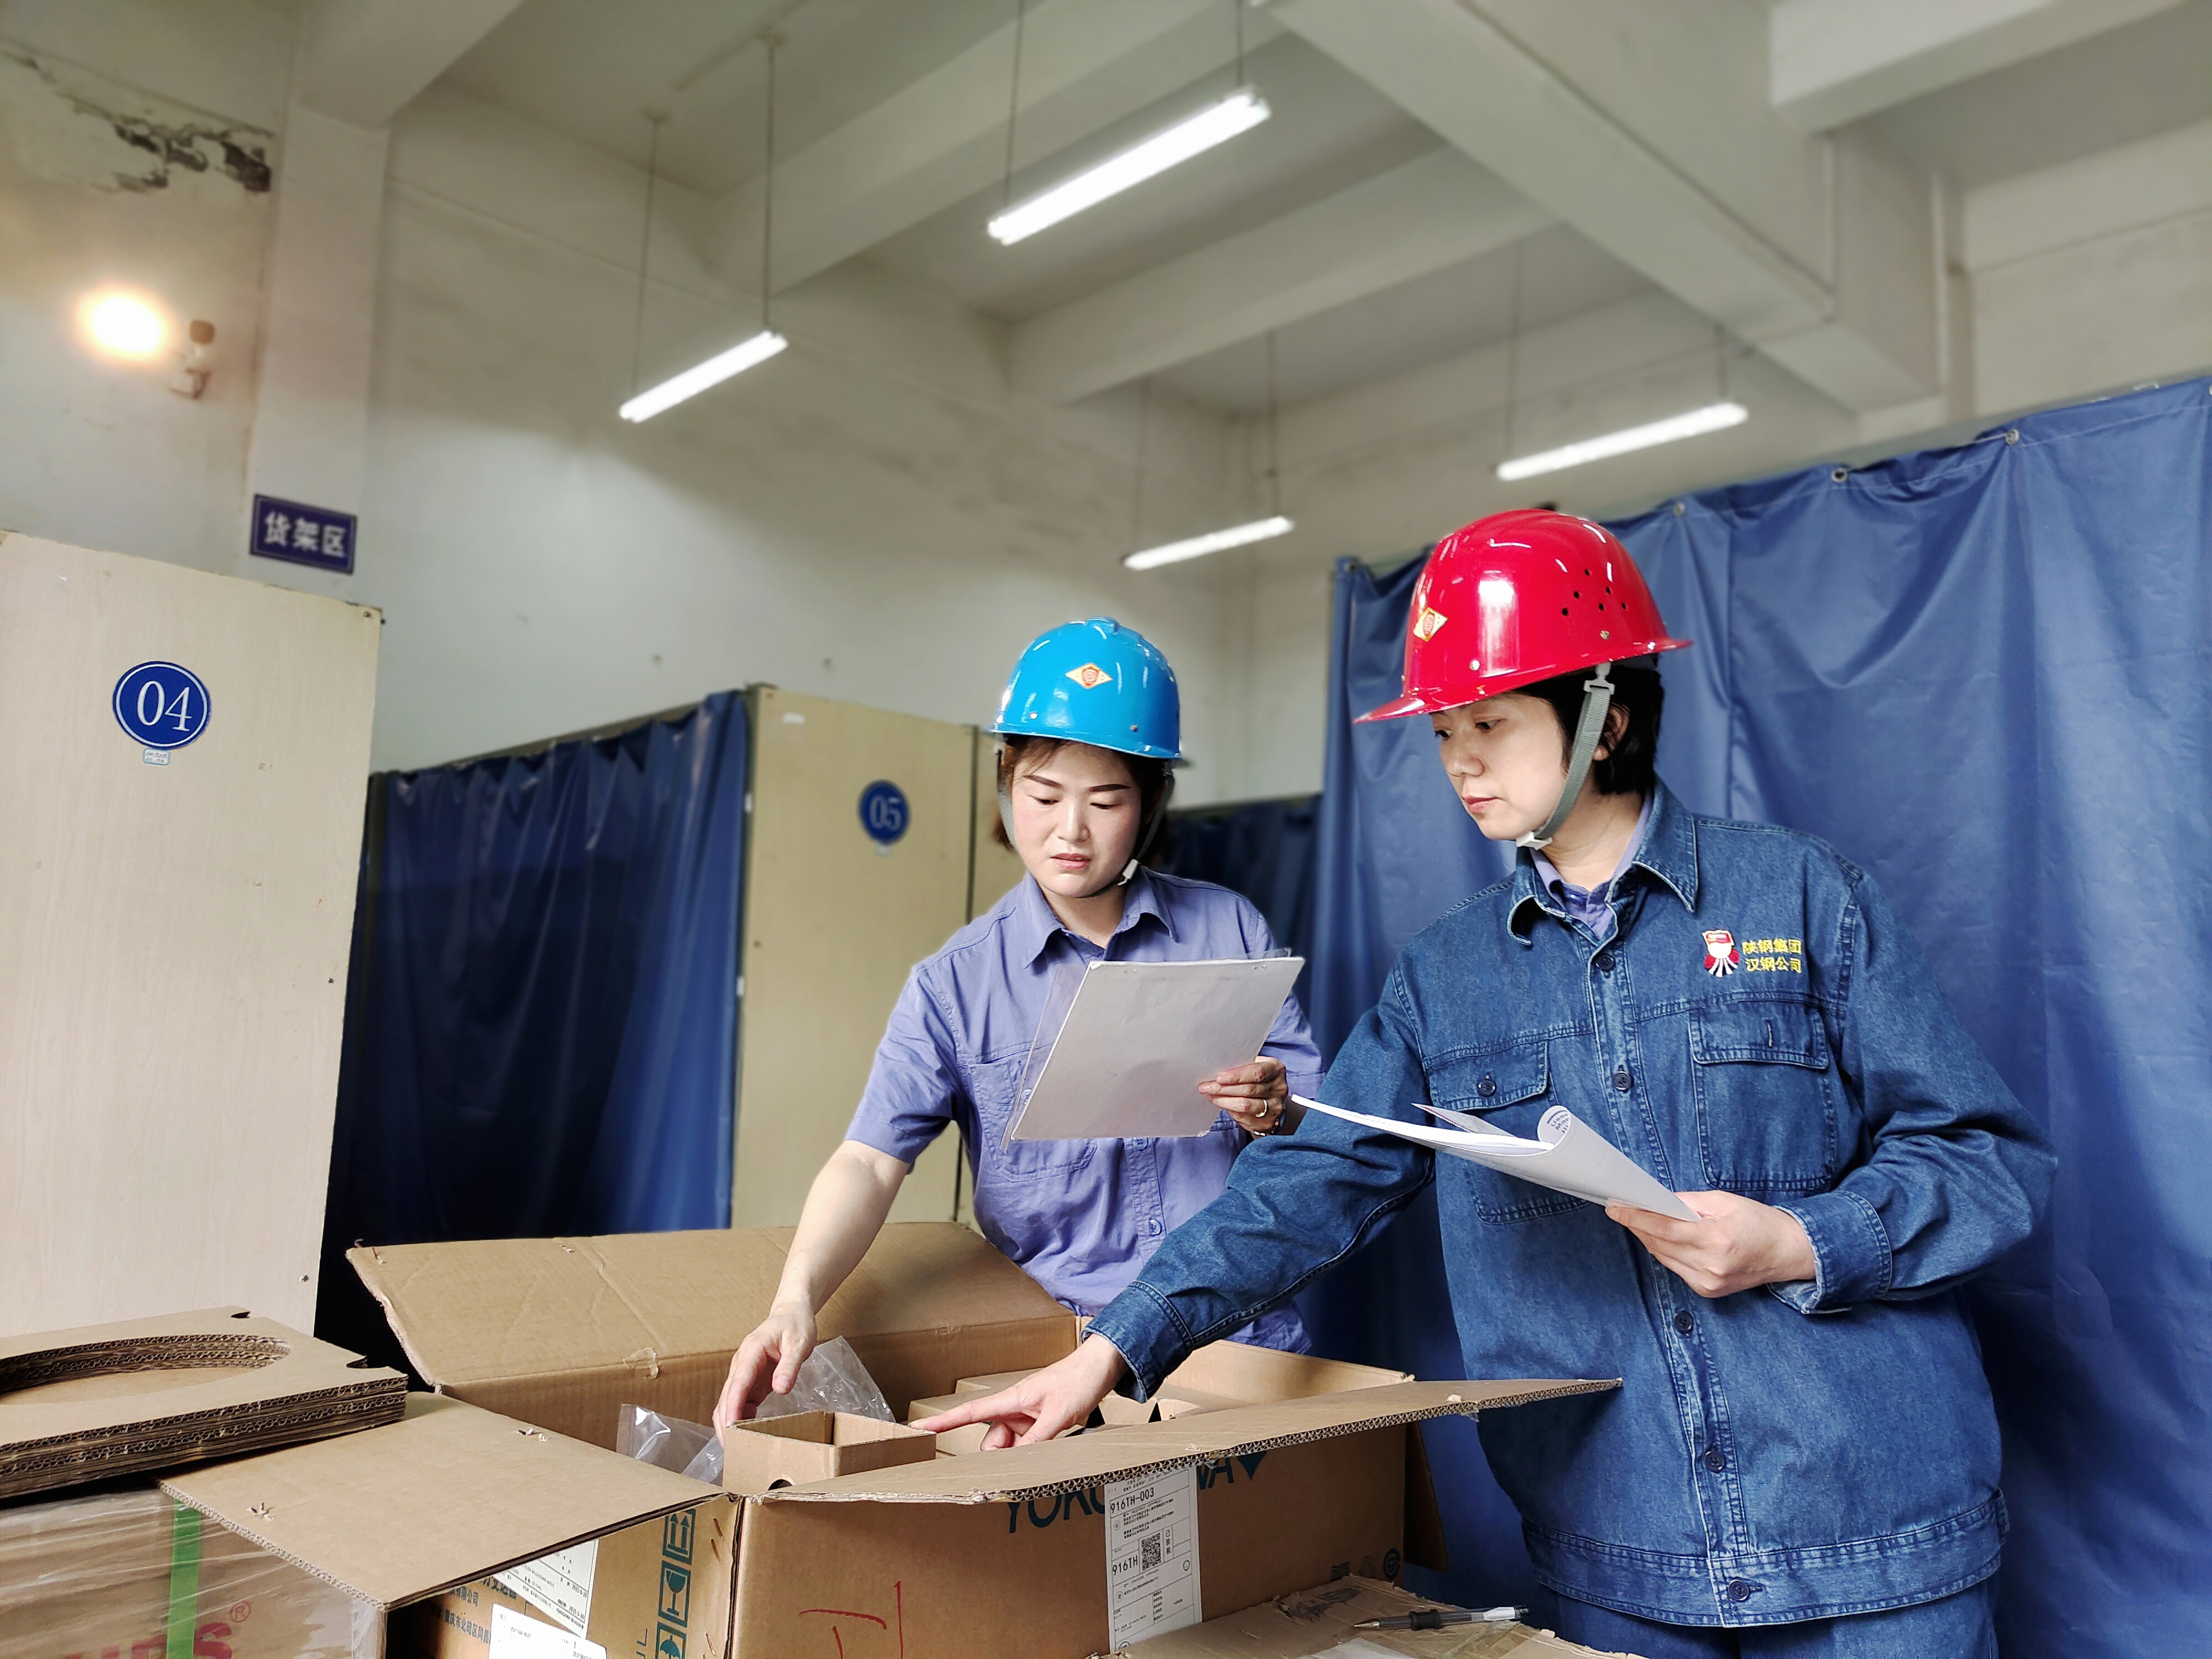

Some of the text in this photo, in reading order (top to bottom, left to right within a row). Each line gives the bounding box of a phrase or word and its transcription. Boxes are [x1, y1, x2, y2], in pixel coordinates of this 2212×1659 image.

[264, 510, 348, 558] 货架区
[137, 680, 193, 732] 04
[869, 794, 902, 832] 05
[1741, 938, 1802, 956] 陕钢集团
[1745, 956, 1802, 974] 汉钢公司
[1110, 1487, 1155, 1514] 916TH-003
[1112, 1554, 1139, 1575] 916TH
